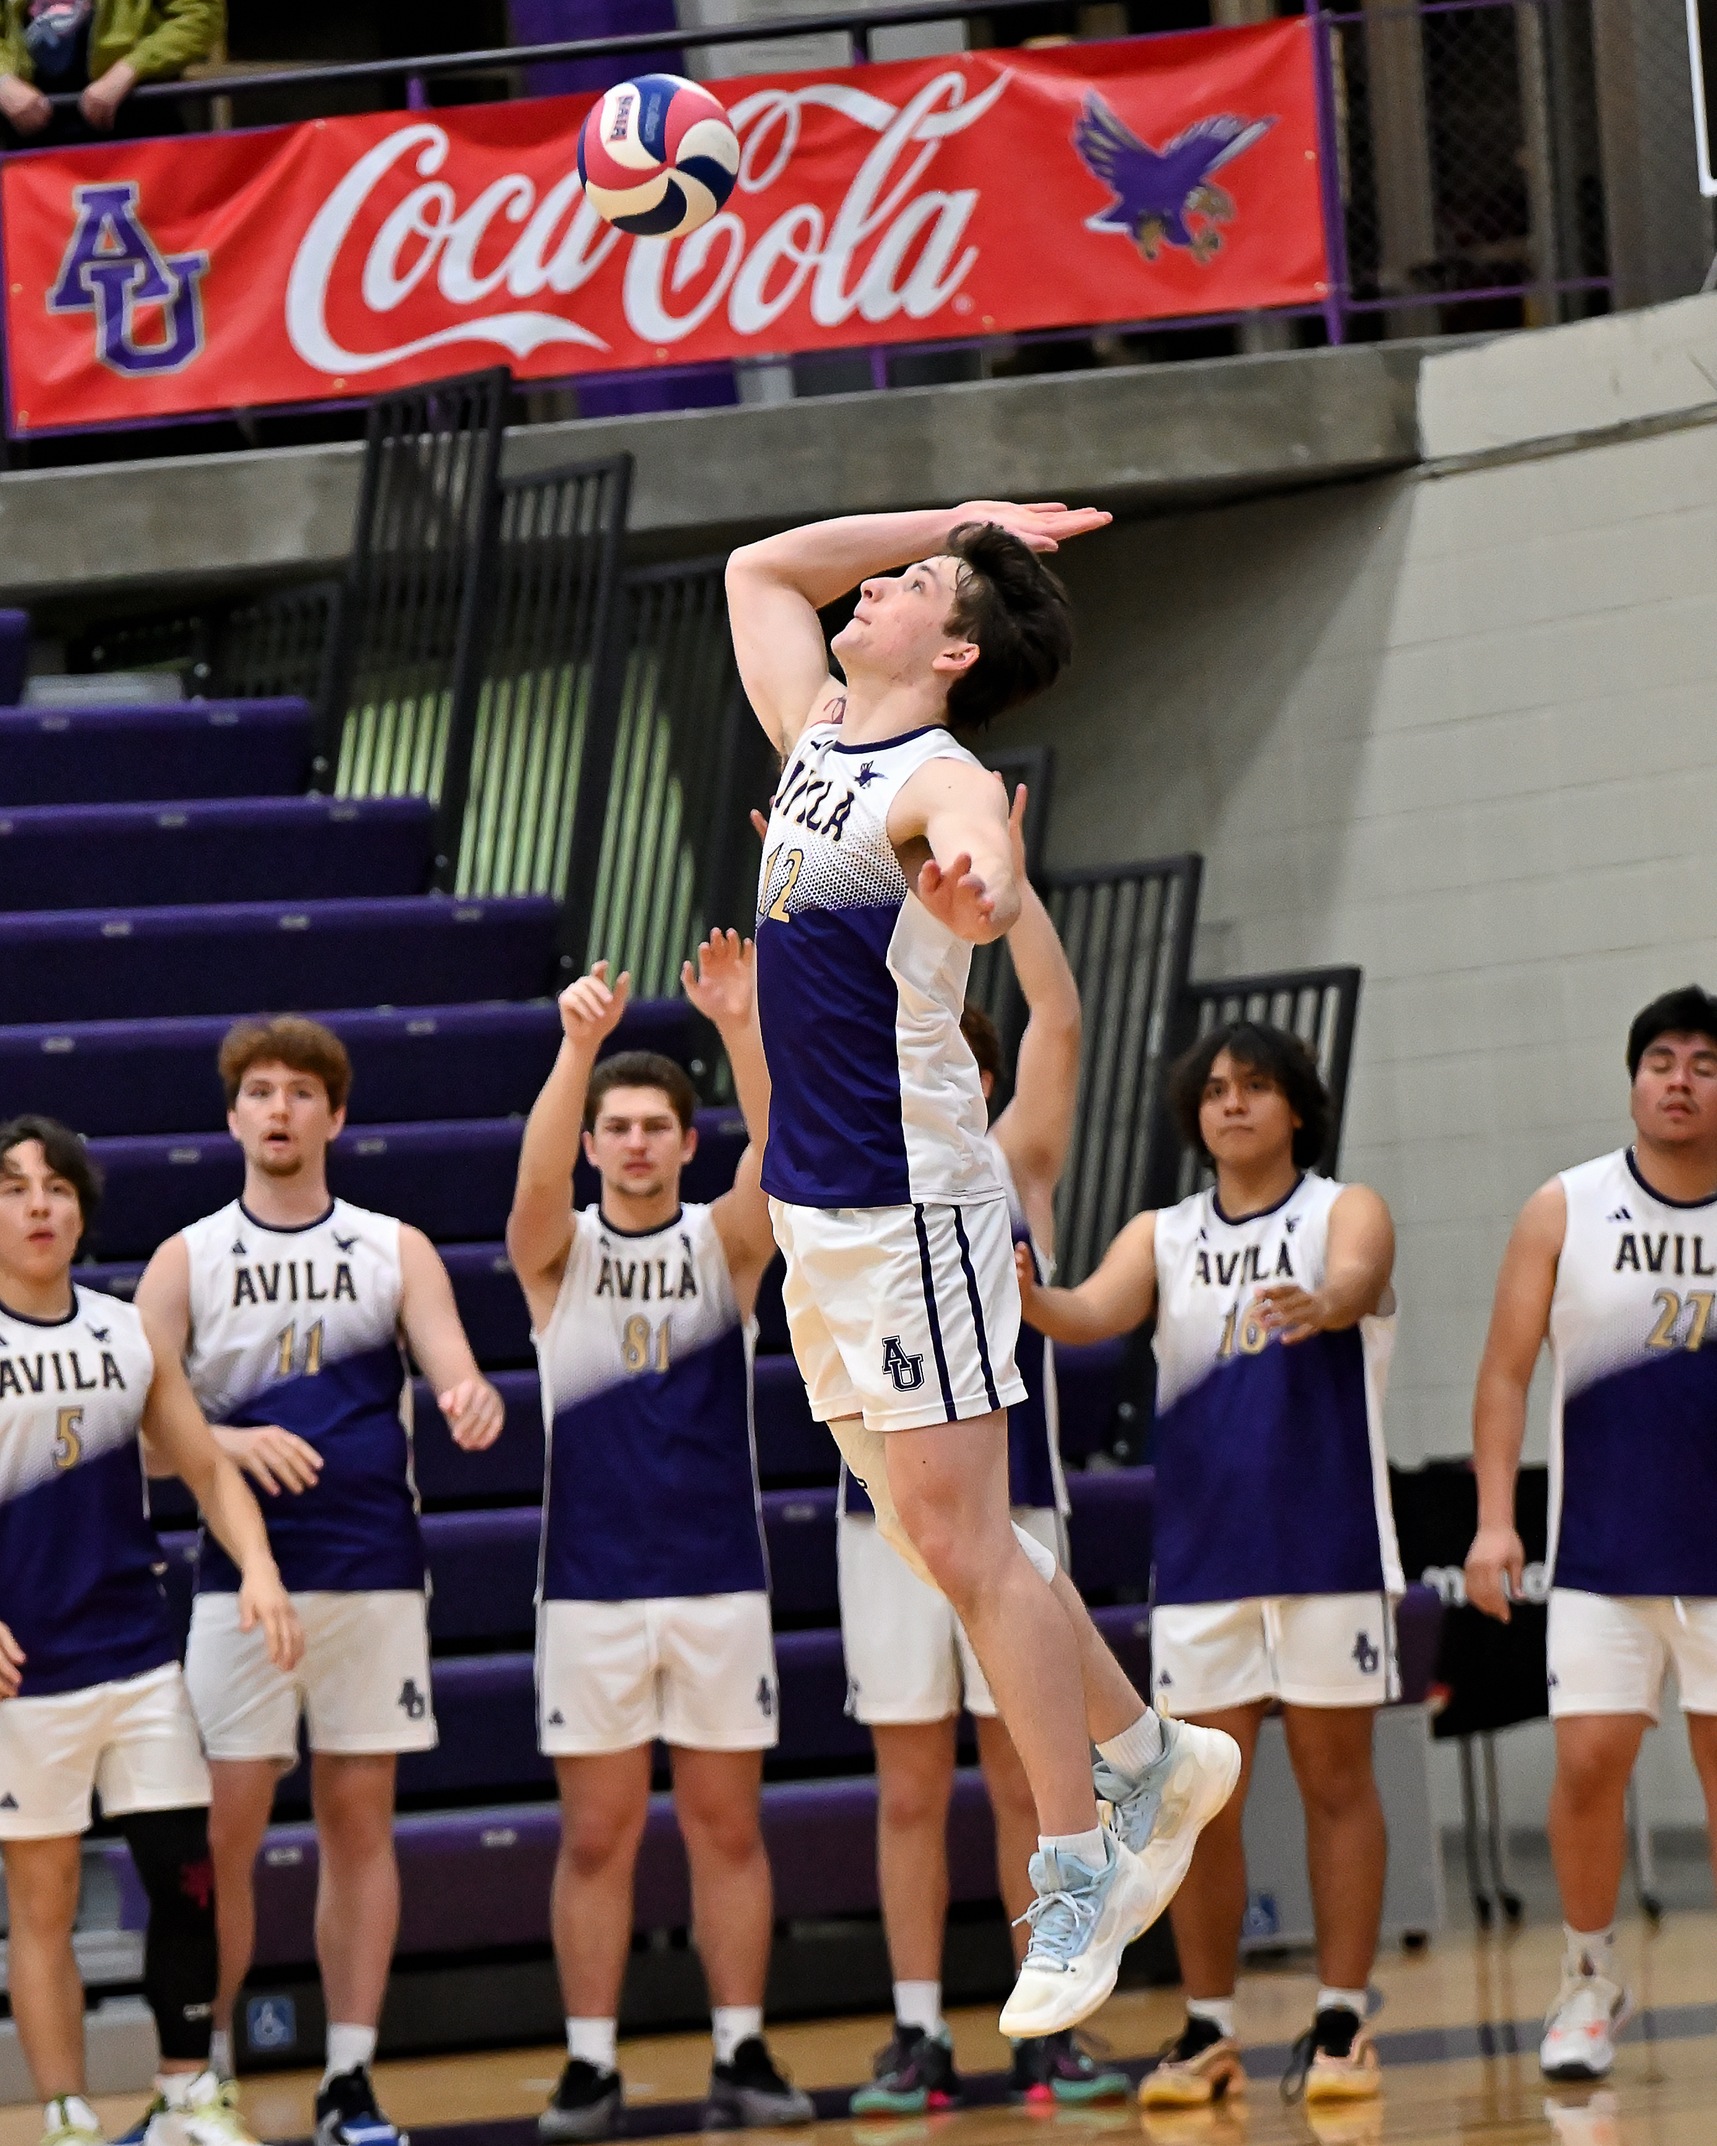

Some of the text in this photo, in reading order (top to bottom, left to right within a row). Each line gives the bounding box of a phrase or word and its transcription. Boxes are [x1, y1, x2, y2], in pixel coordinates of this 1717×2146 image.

[46, 180, 210, 376] AU
[759, 842, 804, 924] 12
[233, 1259, 358, 1308] AVILA
[595, 1256, 699, 1301] AVILA
[1192, 1241, 1295, 1286] AVILA
[279, 1316, 326, 1377] 11
[621, 1312, 672, 1374] 81
[1644, 1288, 1716, 1353] 27
[0, 1348, 127, 1399] AVILA
[882, 1335, 925, 1392] AU
[53, 1405, 84, 1471] 5
